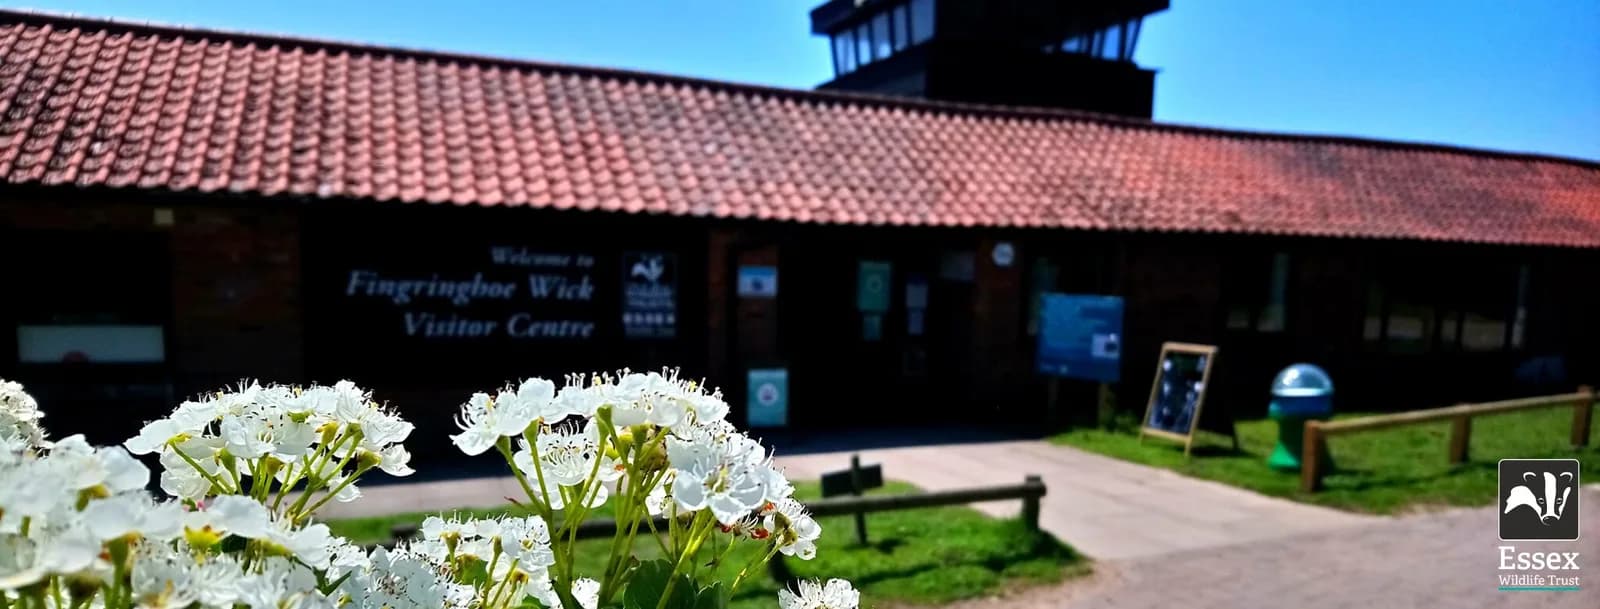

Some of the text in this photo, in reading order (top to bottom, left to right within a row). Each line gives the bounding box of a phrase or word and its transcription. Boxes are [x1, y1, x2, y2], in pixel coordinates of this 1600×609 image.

[492, 245, 595, 266] Welcome to
[346, 270, 517, 304] Fingringhoe
[529, 274, 595, 300] Wick
[404, 312, 498, 338] Visitor
[507, 312, 595, 338] Centre
